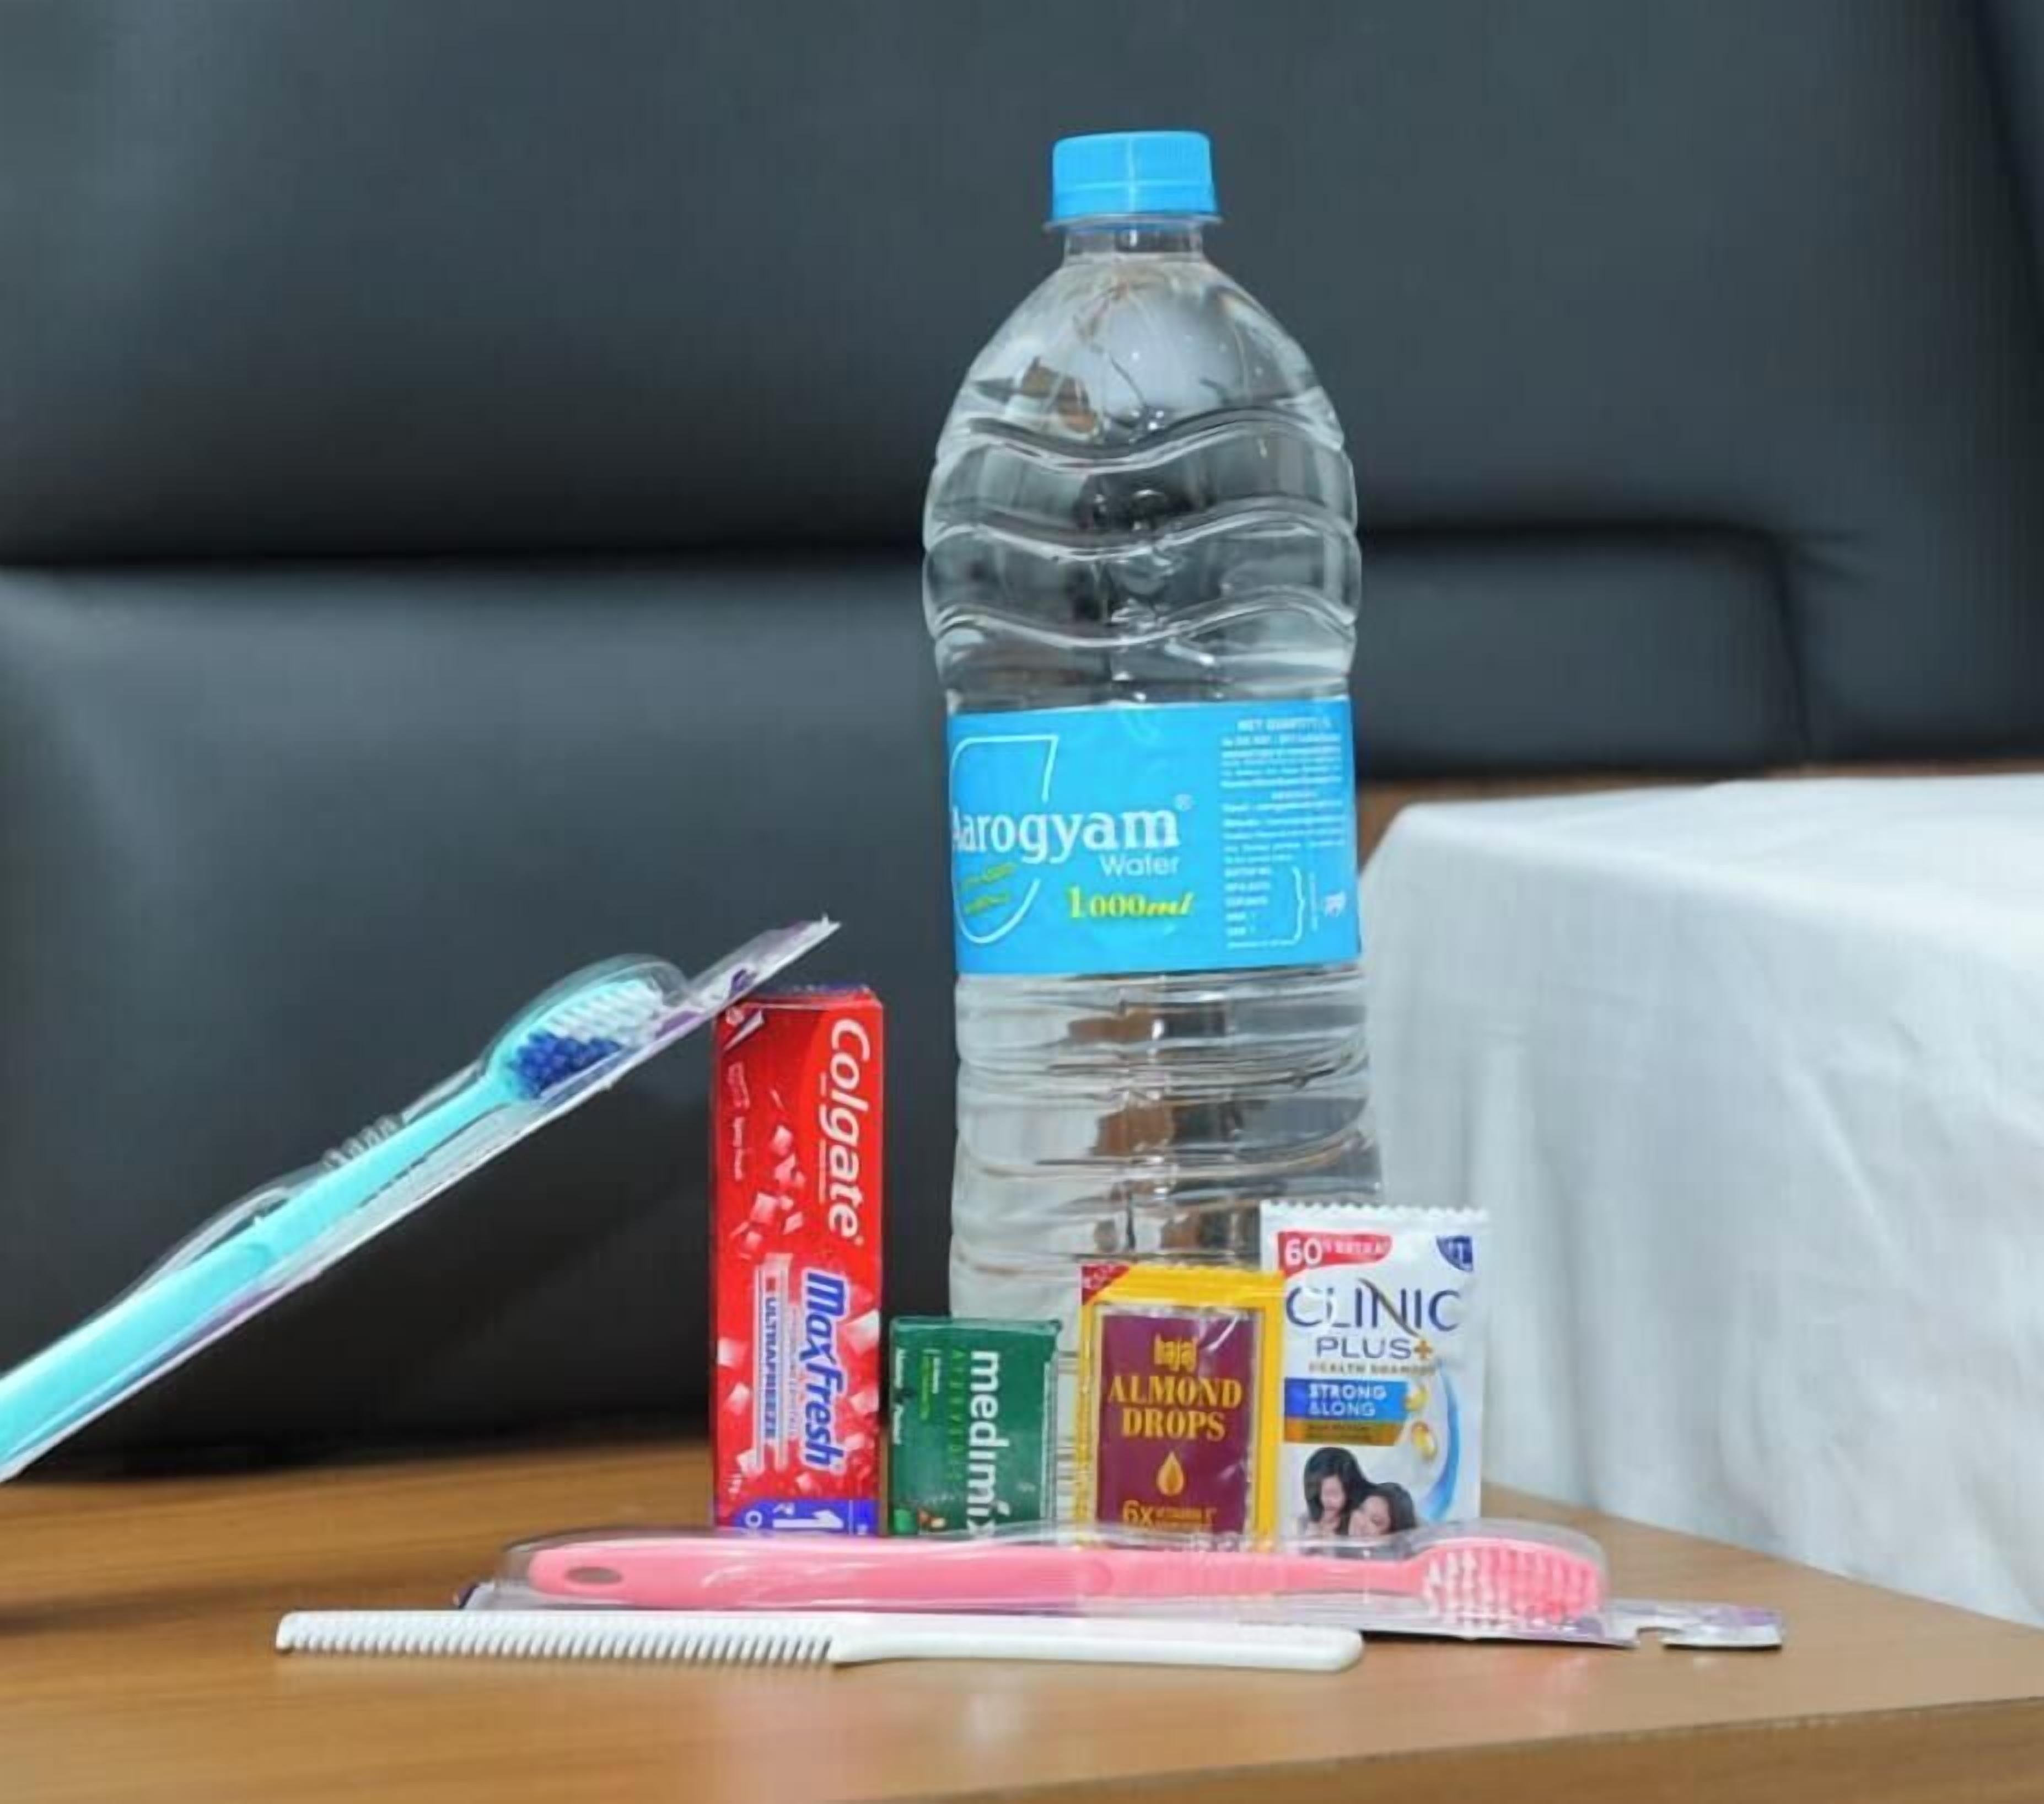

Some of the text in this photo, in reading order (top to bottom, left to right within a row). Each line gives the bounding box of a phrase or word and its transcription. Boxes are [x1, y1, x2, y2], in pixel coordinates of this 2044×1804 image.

[1099, 853, 1180, 877] Water
[819, 1018, 870, 1238] Colgate
[1286, 1277, 1461, 1338] CLINIC
[1109, 1375, 1243, 1409] ALMOND
[1309, 1383, 1387, 1400] STRONG
[1122, 1407, 1226, 1442] DROPS
